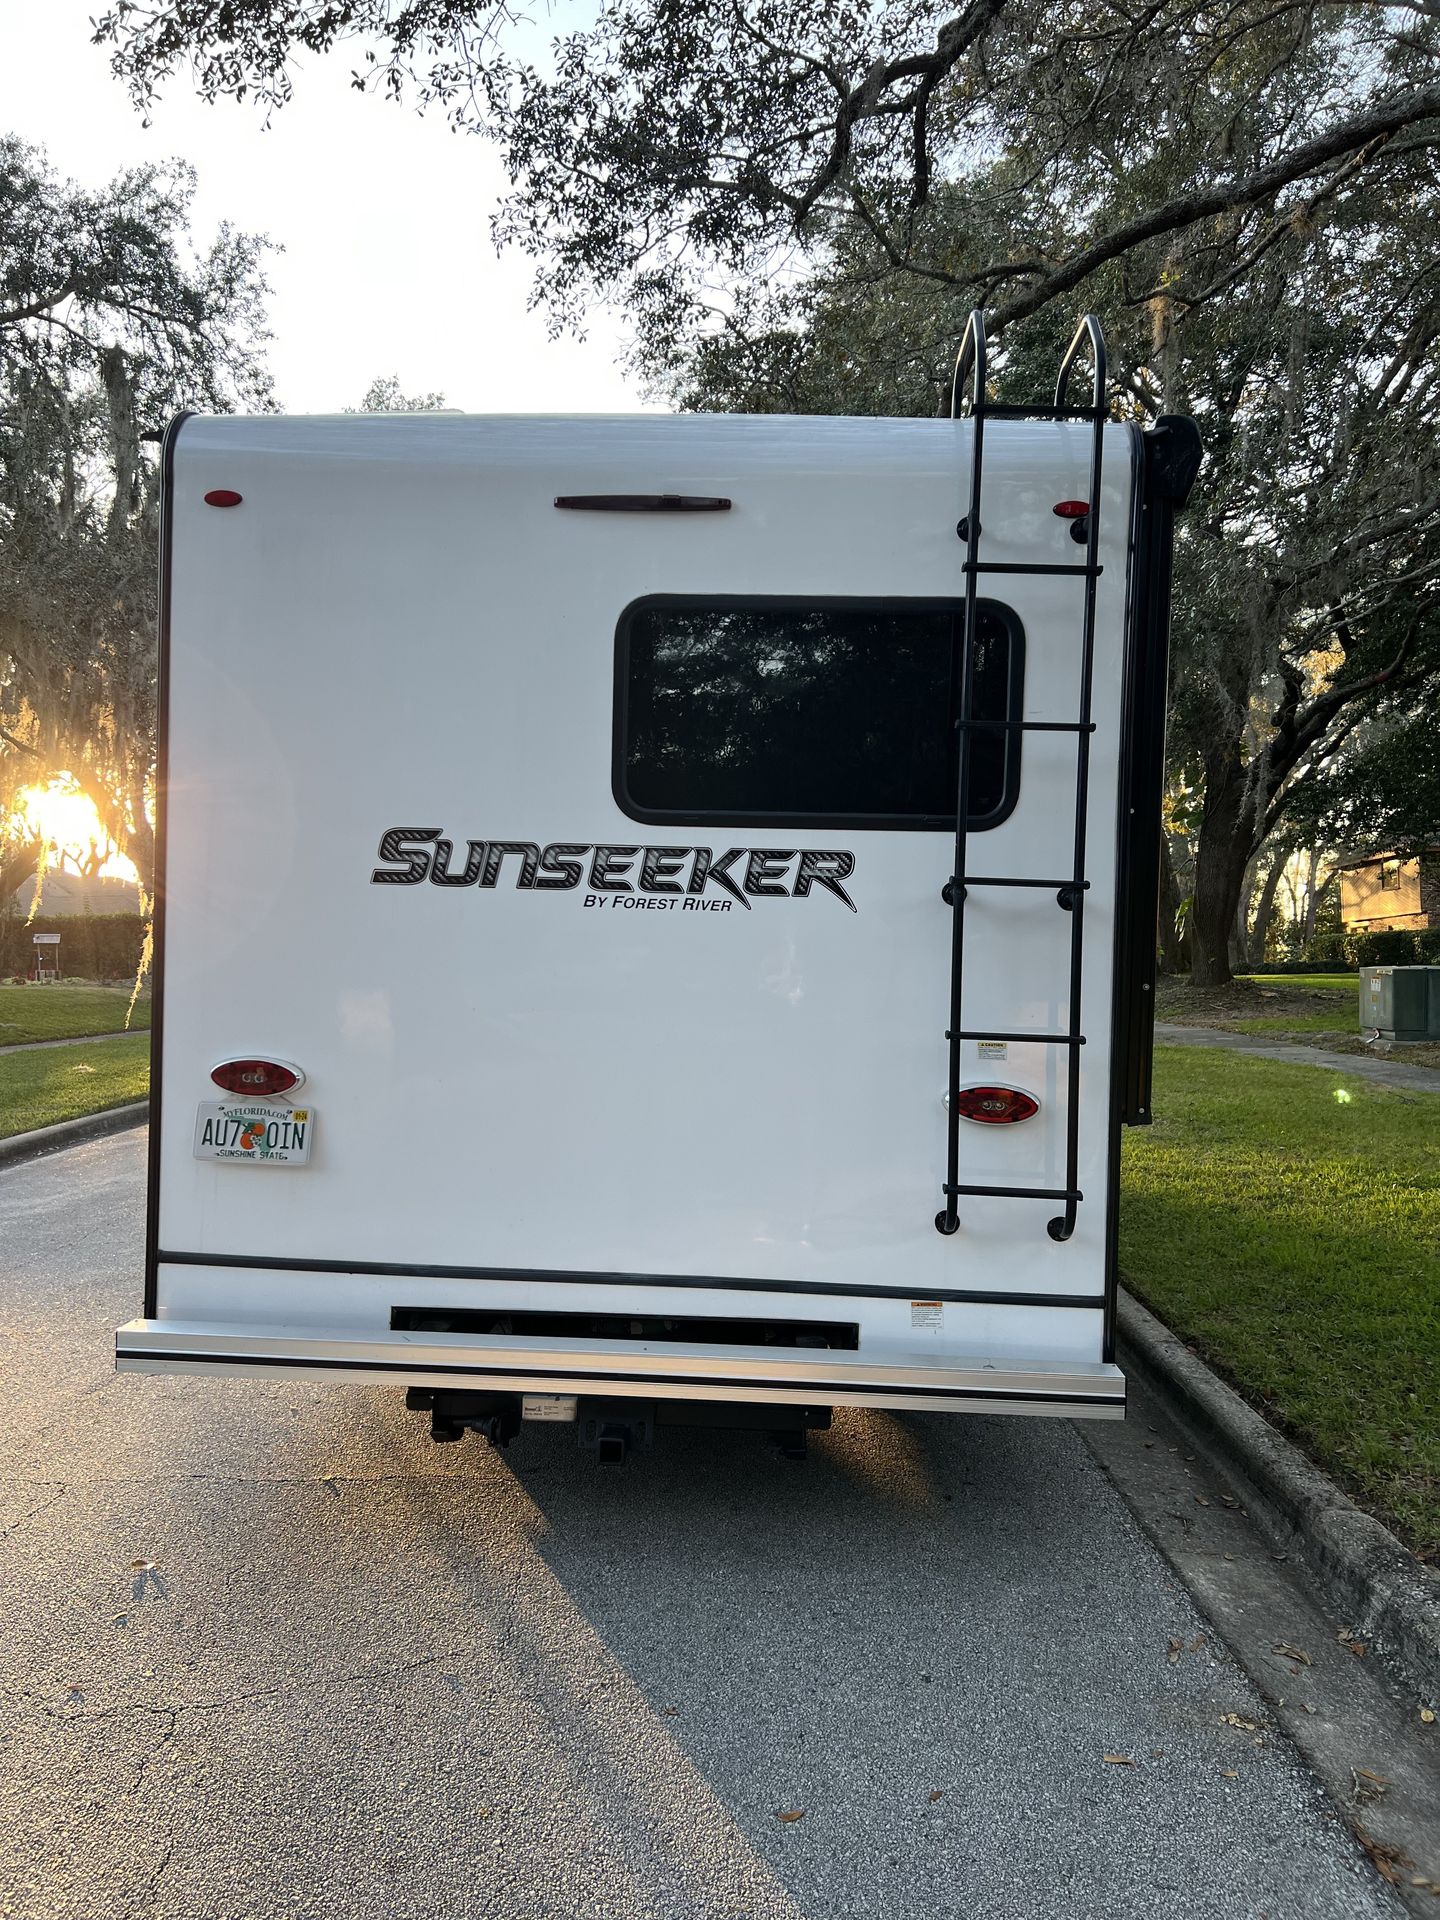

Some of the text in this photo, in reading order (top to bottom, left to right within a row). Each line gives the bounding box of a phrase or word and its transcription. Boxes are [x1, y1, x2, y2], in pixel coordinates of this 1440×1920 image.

[612, 895, 678, 910] FOREST
[682, 897, 732, 912] RIVER
[201, 1118, 240, 1147] AU7
[220, 1150, 283, 1160] SUNSHINE STATE
